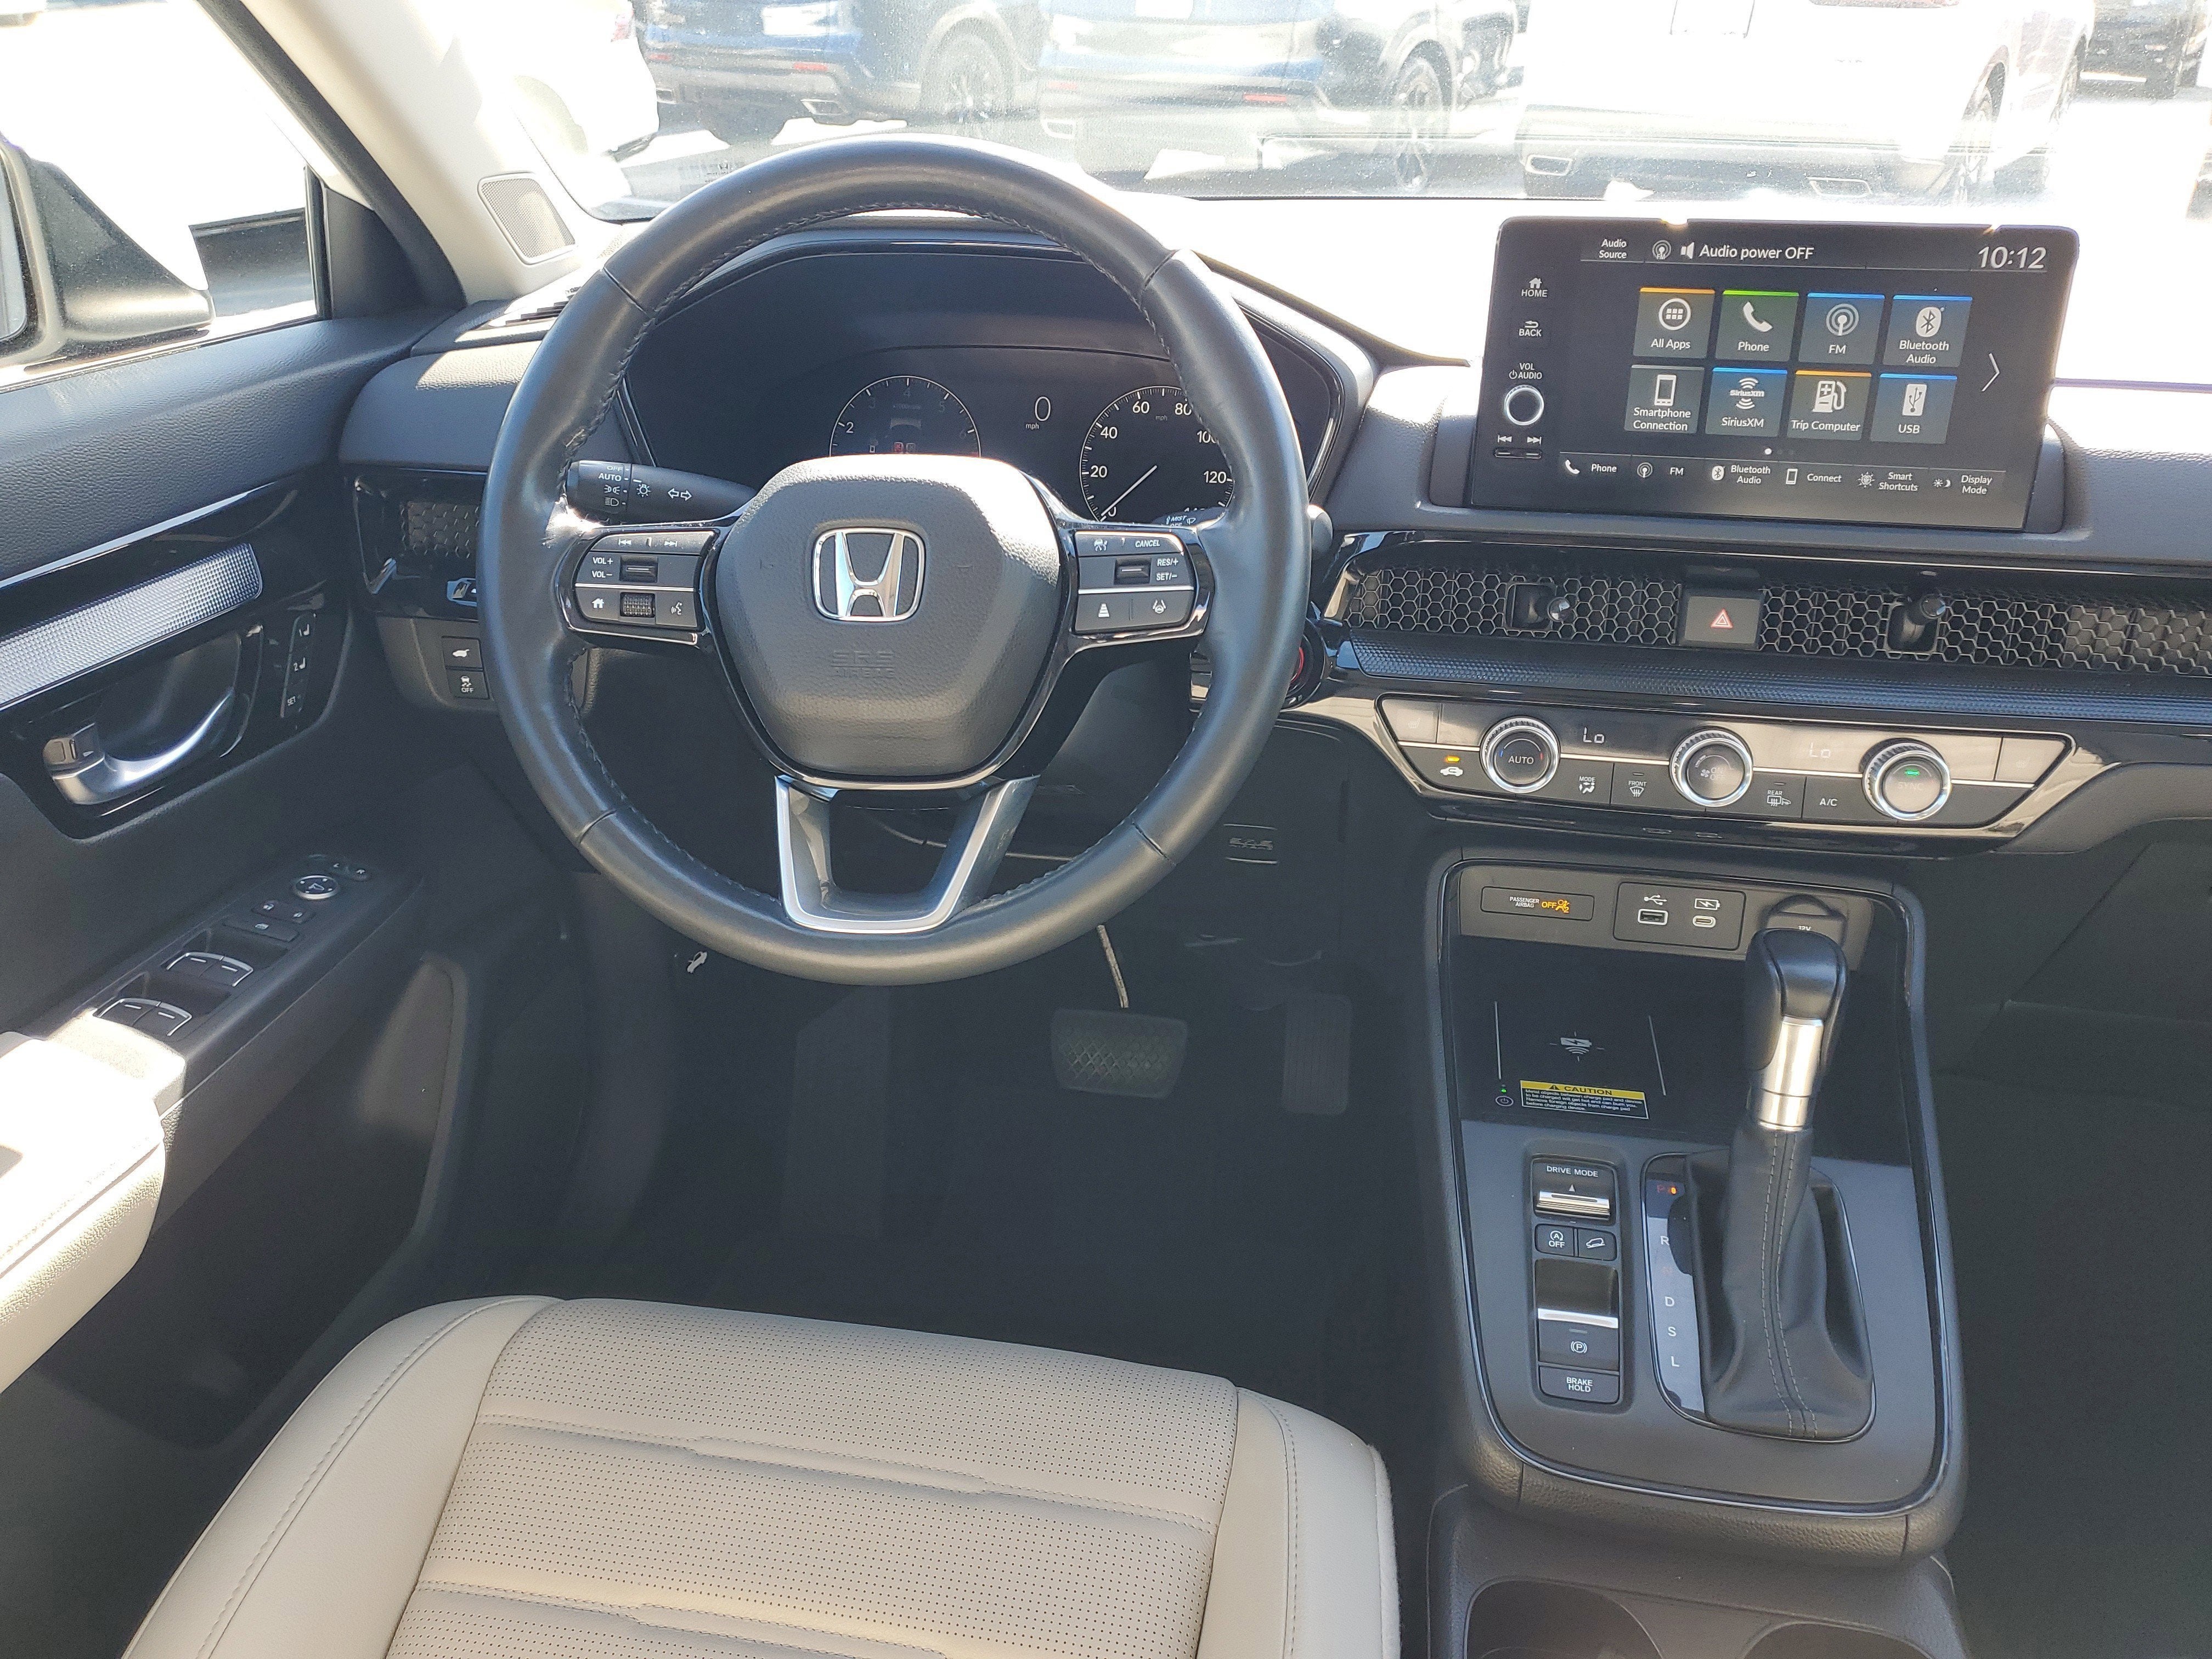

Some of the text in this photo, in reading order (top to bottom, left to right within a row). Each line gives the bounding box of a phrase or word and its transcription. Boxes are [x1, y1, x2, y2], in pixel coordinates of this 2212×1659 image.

[1601, 239, 1627, 247] Audio
[1599, 250, 1627, 259] Source
[1699, 244, 1815, 261] Audio power OFF
[1978, 246, 2047, 269] 10:12
[1521, 289, 1548, 297] HOME
[1519, 329, 1542, 337] BACK
[1651, 338, 1691, 350] All Apps
[1737, 341, 1769, 352] Phone
[1899, 340, 1949, 351] Bluetooth
[1828, 345, 1846, 354] FM
[1906, 354, 1936, 364] Audio
[1035, 396, 1051, 421] 0
[1132, 400, 1150, 414] 60
[1633, 407, 1691, 419] Smartphone
[845, 421, 854, 433] 2
[1633, 420, 1688, 431] Connection
[1721, 417, 1764, 427] SiriusXM
[1791, 420, 1861, 432] Trip Computer
[1100, 426, 1118, 439] 40
[1898, 424, 1920, 434] USB
[1090, 465, 1108, 478] 20
[1591, 464, 1617, 473] Phone
[1670, 467, 1684, 476] FM
[1730, 465, 1771, 475] Bluetooth
[598, 472, 622, 482] AUTO
[1203, 470, 1227, 484] 120
[1736, 476, 1762, 484] Audio
[1807, 473, 1842, 483] Connect
[1888, 472, 1912, 481] Smart
[1961, 475, 1993, 486] Display
[1878, 482, 1918, 492] Shortcuts
[1962, 486, 1987, 494] Mode
[1135, 539, 1160, 548] CANCEL
[592, 557, 613, 565] VOL+
[1157, 558, 1179, 567] RES/+
[1583, 726, 1605, 744] Lo
[1508, 755, 1534, 765] AUTO
[1897, 781, 1924, 790] SYNC
[1819, 798, 1838, 807] A/C
[1564, 1086, 1612, 1096] CAUTION
[1547, 1165, 1599, 1177] DRIVE MODE
[1660, 1235, 1670, 1246] R
[1664, 1296, 1675, 1306] D
[1668, 1326, 1677, 1337] S
[1671, 1356, 1680, 1367] L
[1566, 1376, 1593, 1386] BRAKE
[1568, 1384, 1591, 1392] HOLD
